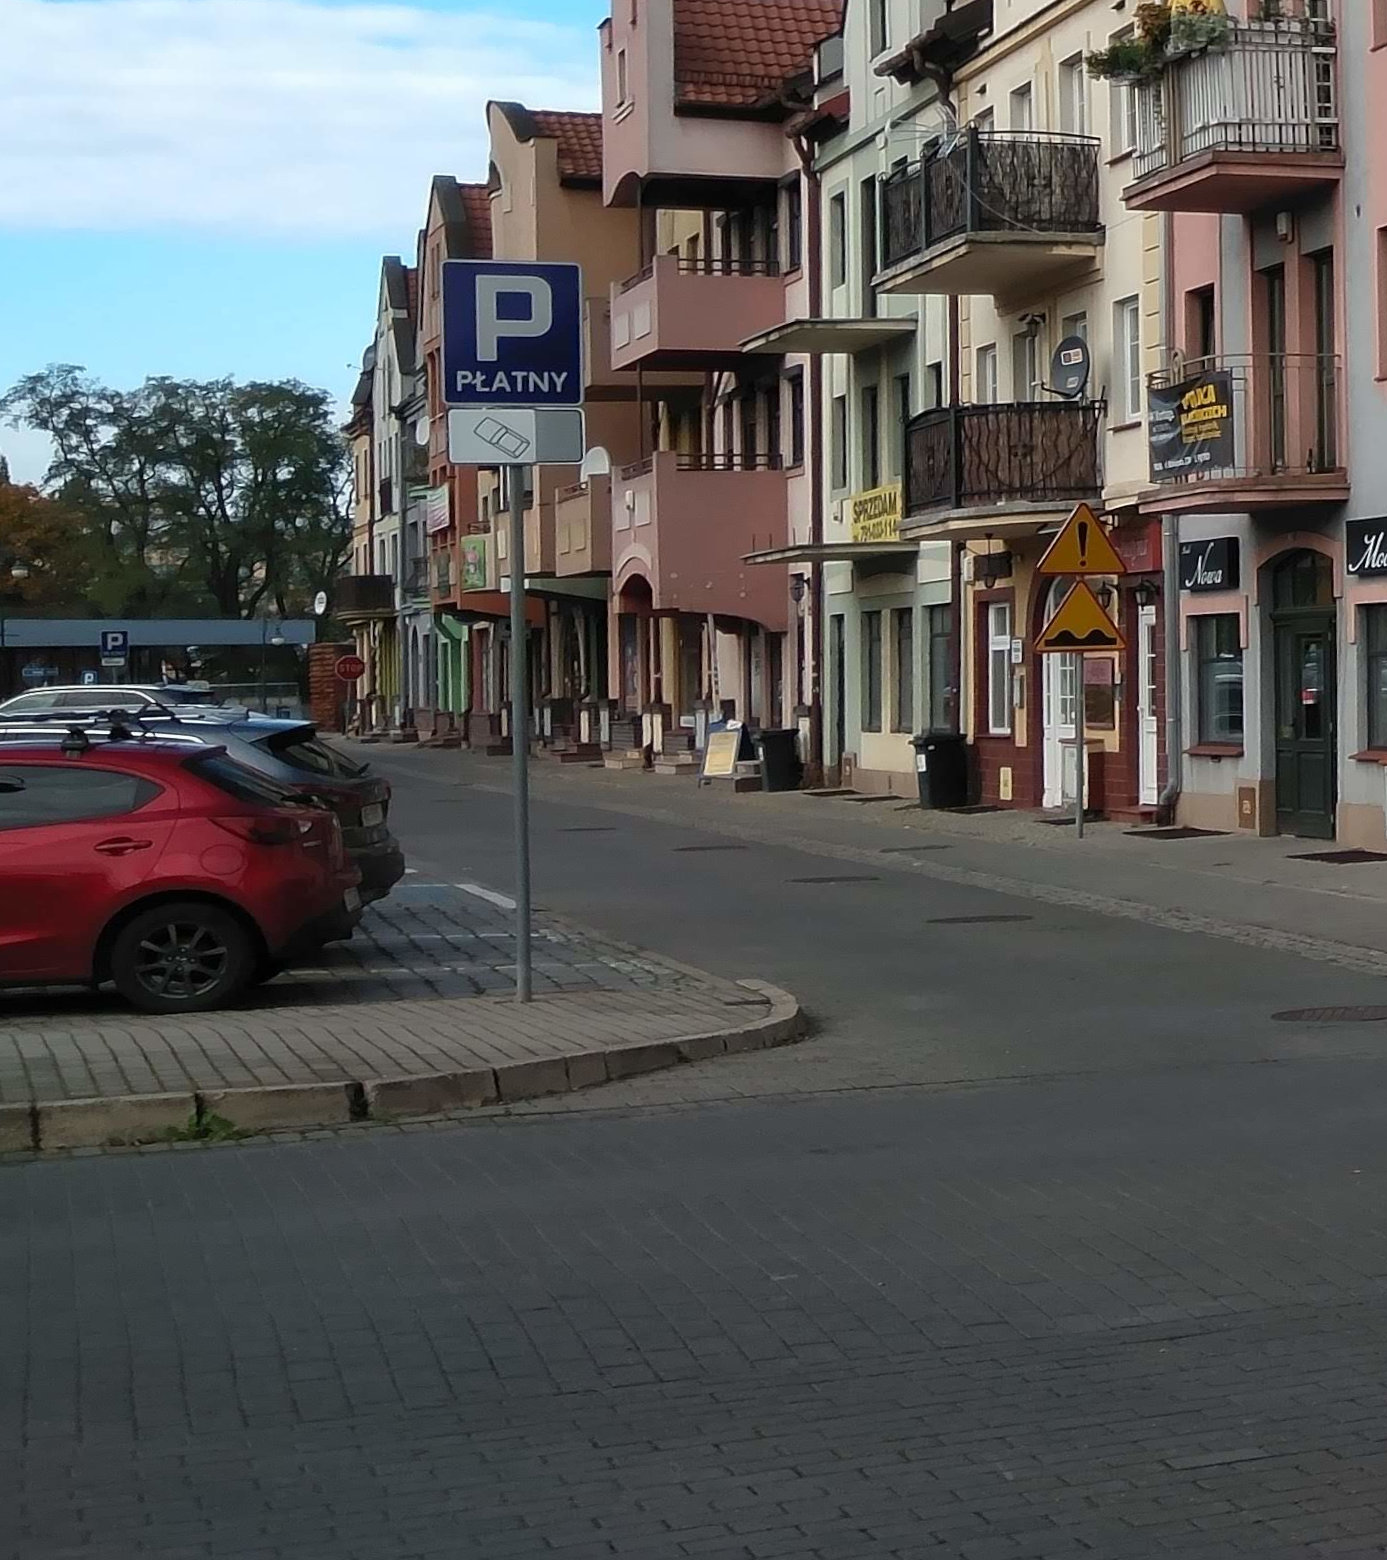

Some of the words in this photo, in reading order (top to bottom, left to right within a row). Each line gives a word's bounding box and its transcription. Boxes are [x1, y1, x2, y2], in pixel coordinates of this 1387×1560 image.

[475, 274, 553, 362] P
[456, 370, 568, 393] PŁATNY
[853, 491, 897, 524] SPRZEDAM
[1185, 542, 1222, 588] Nowa
[107, 633, 124, 650] P
